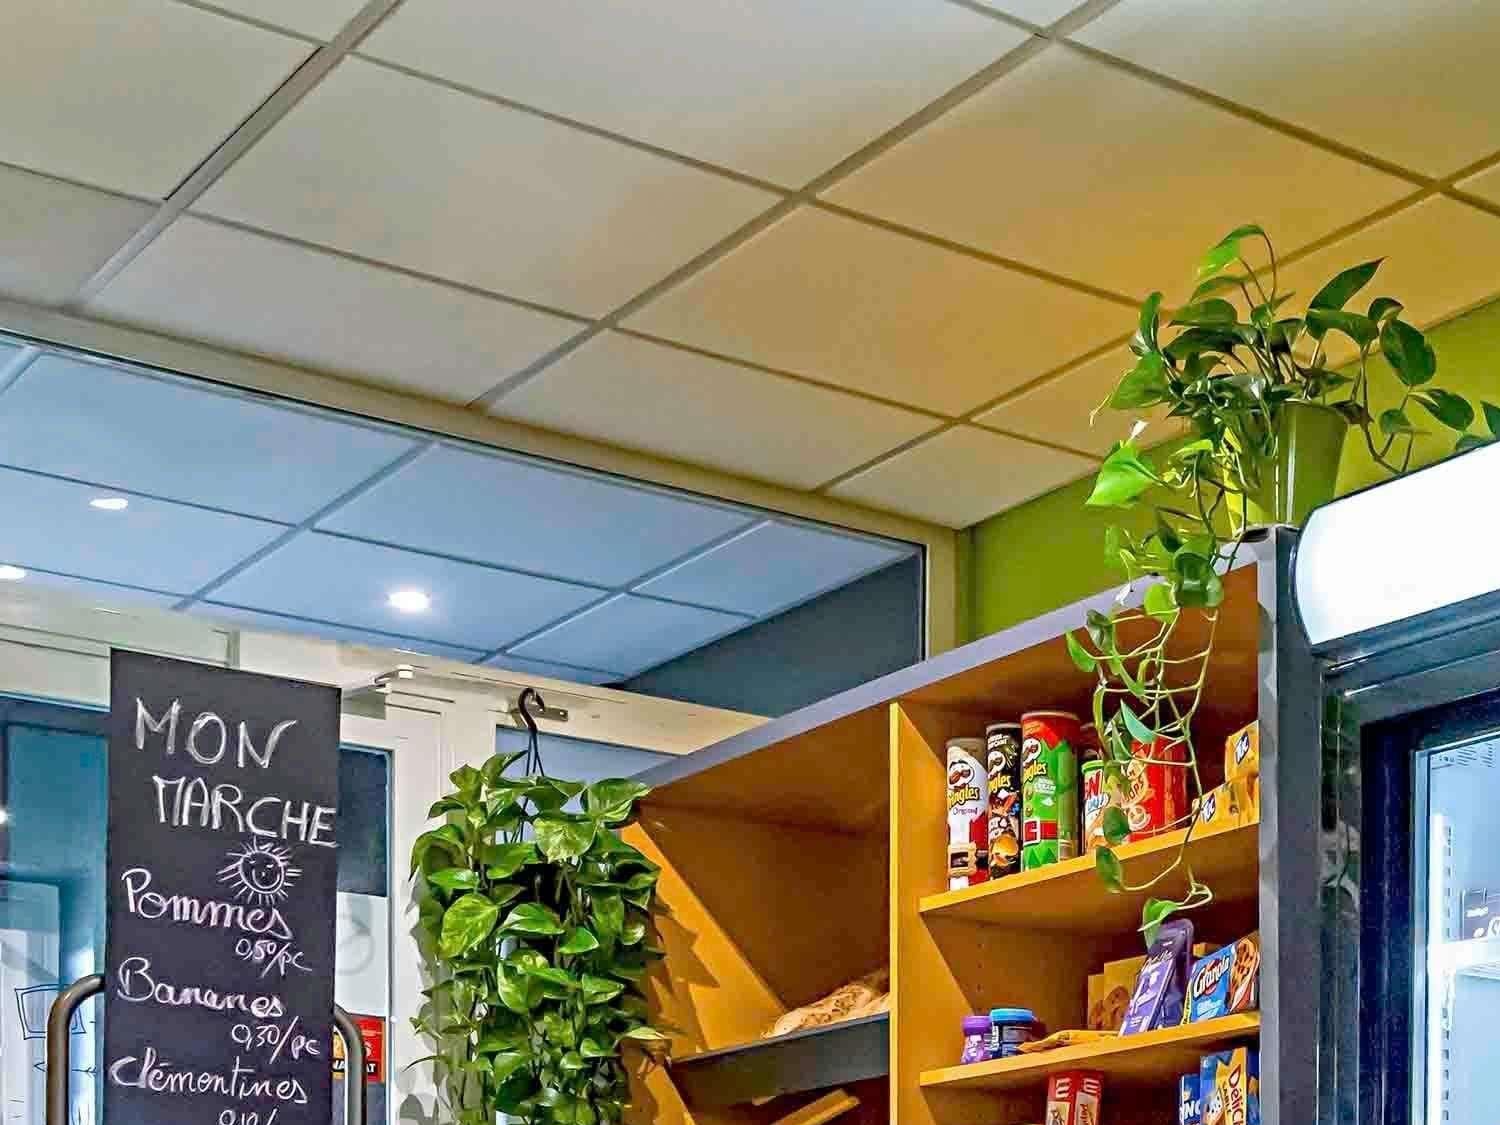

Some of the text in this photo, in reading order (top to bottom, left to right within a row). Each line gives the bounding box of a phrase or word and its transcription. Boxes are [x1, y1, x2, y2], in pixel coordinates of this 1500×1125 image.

[135, 696, 298, 769] MON
[152, 775, 338, 848] MARCHE
[121, 867, 294, 940] Pommes
[117, 956, 284, 1018] Bananes
[1193, 954, 1231, 998] Granola
